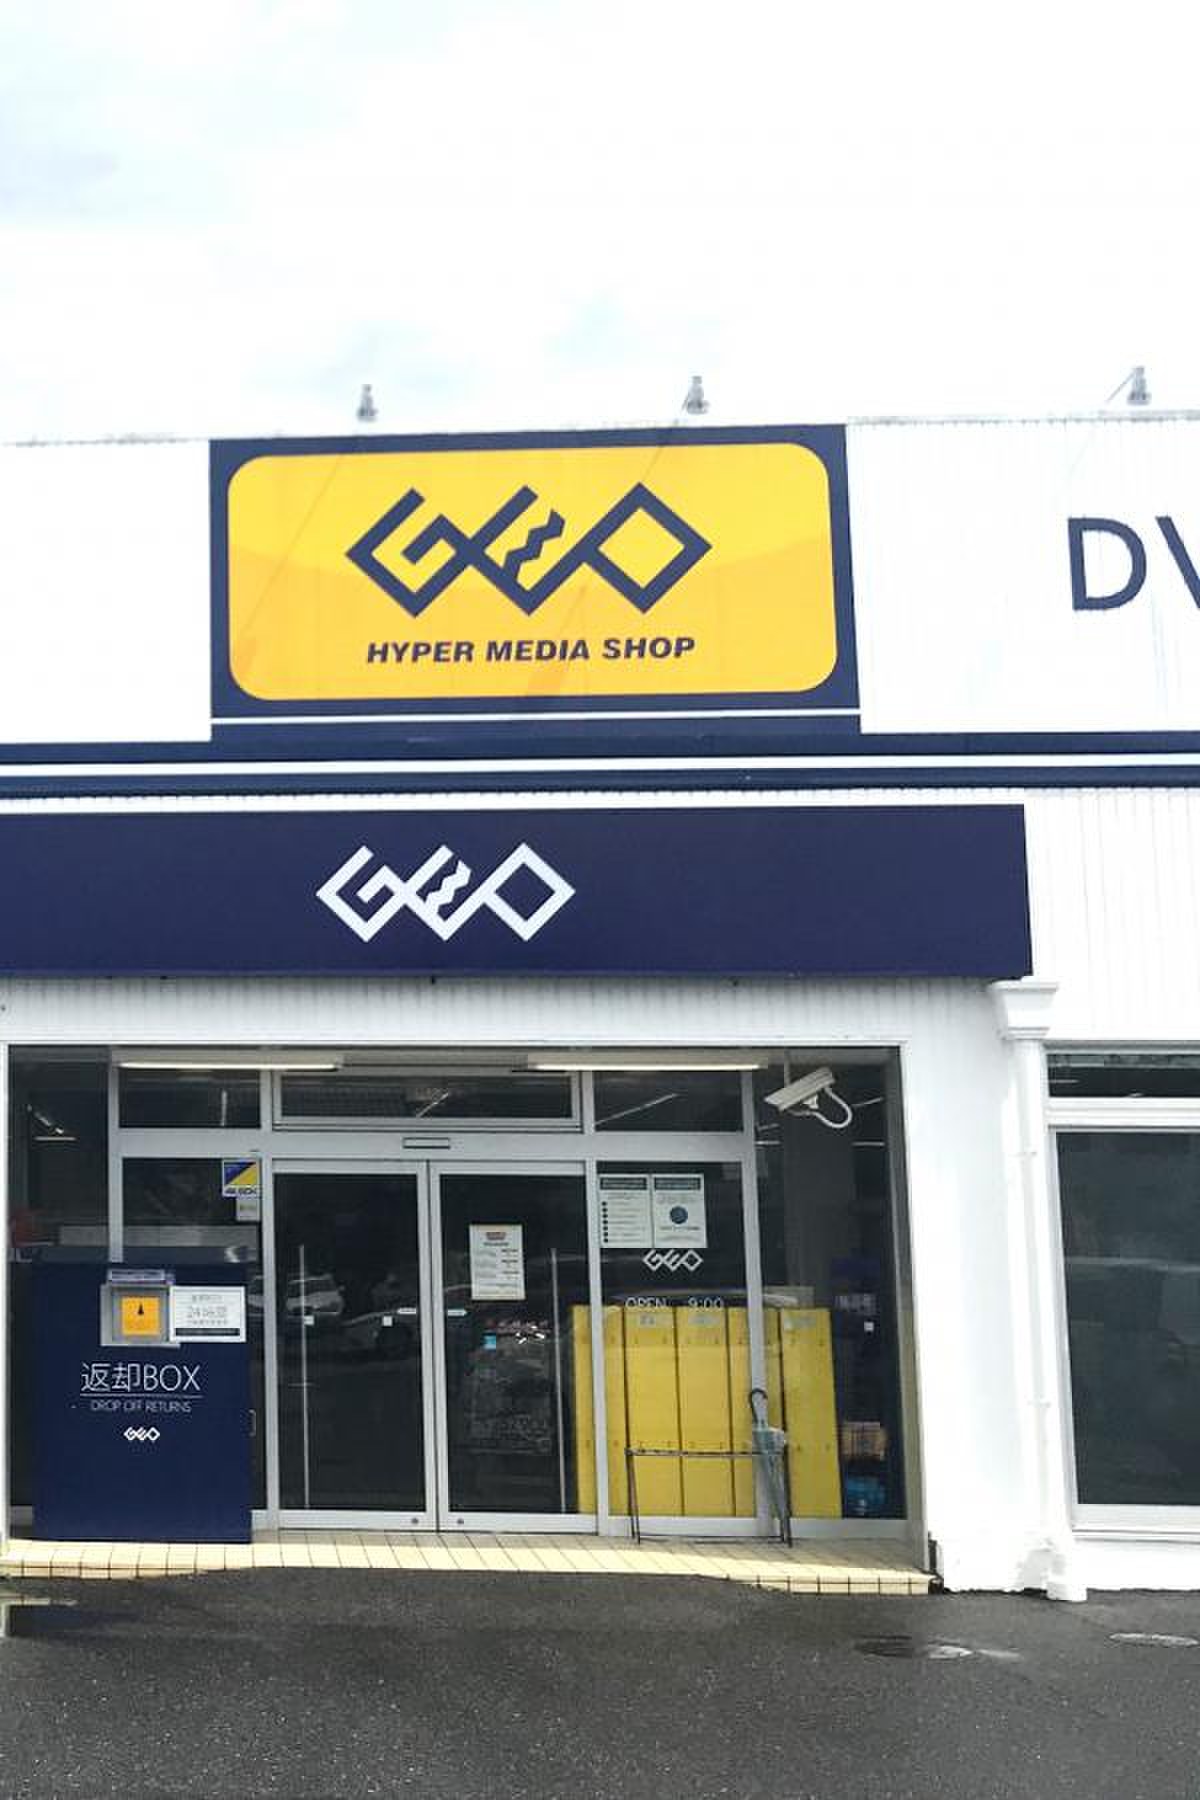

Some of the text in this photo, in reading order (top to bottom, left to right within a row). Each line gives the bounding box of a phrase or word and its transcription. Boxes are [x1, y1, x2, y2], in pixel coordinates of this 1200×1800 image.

[346, 482, 712, 618] GEO
[367, 637, 695, 664] HYPER MEDIA SHOP
[315, 843, 576, 943] GEO
[81, 1362, 201, 1392] 返却BOX
